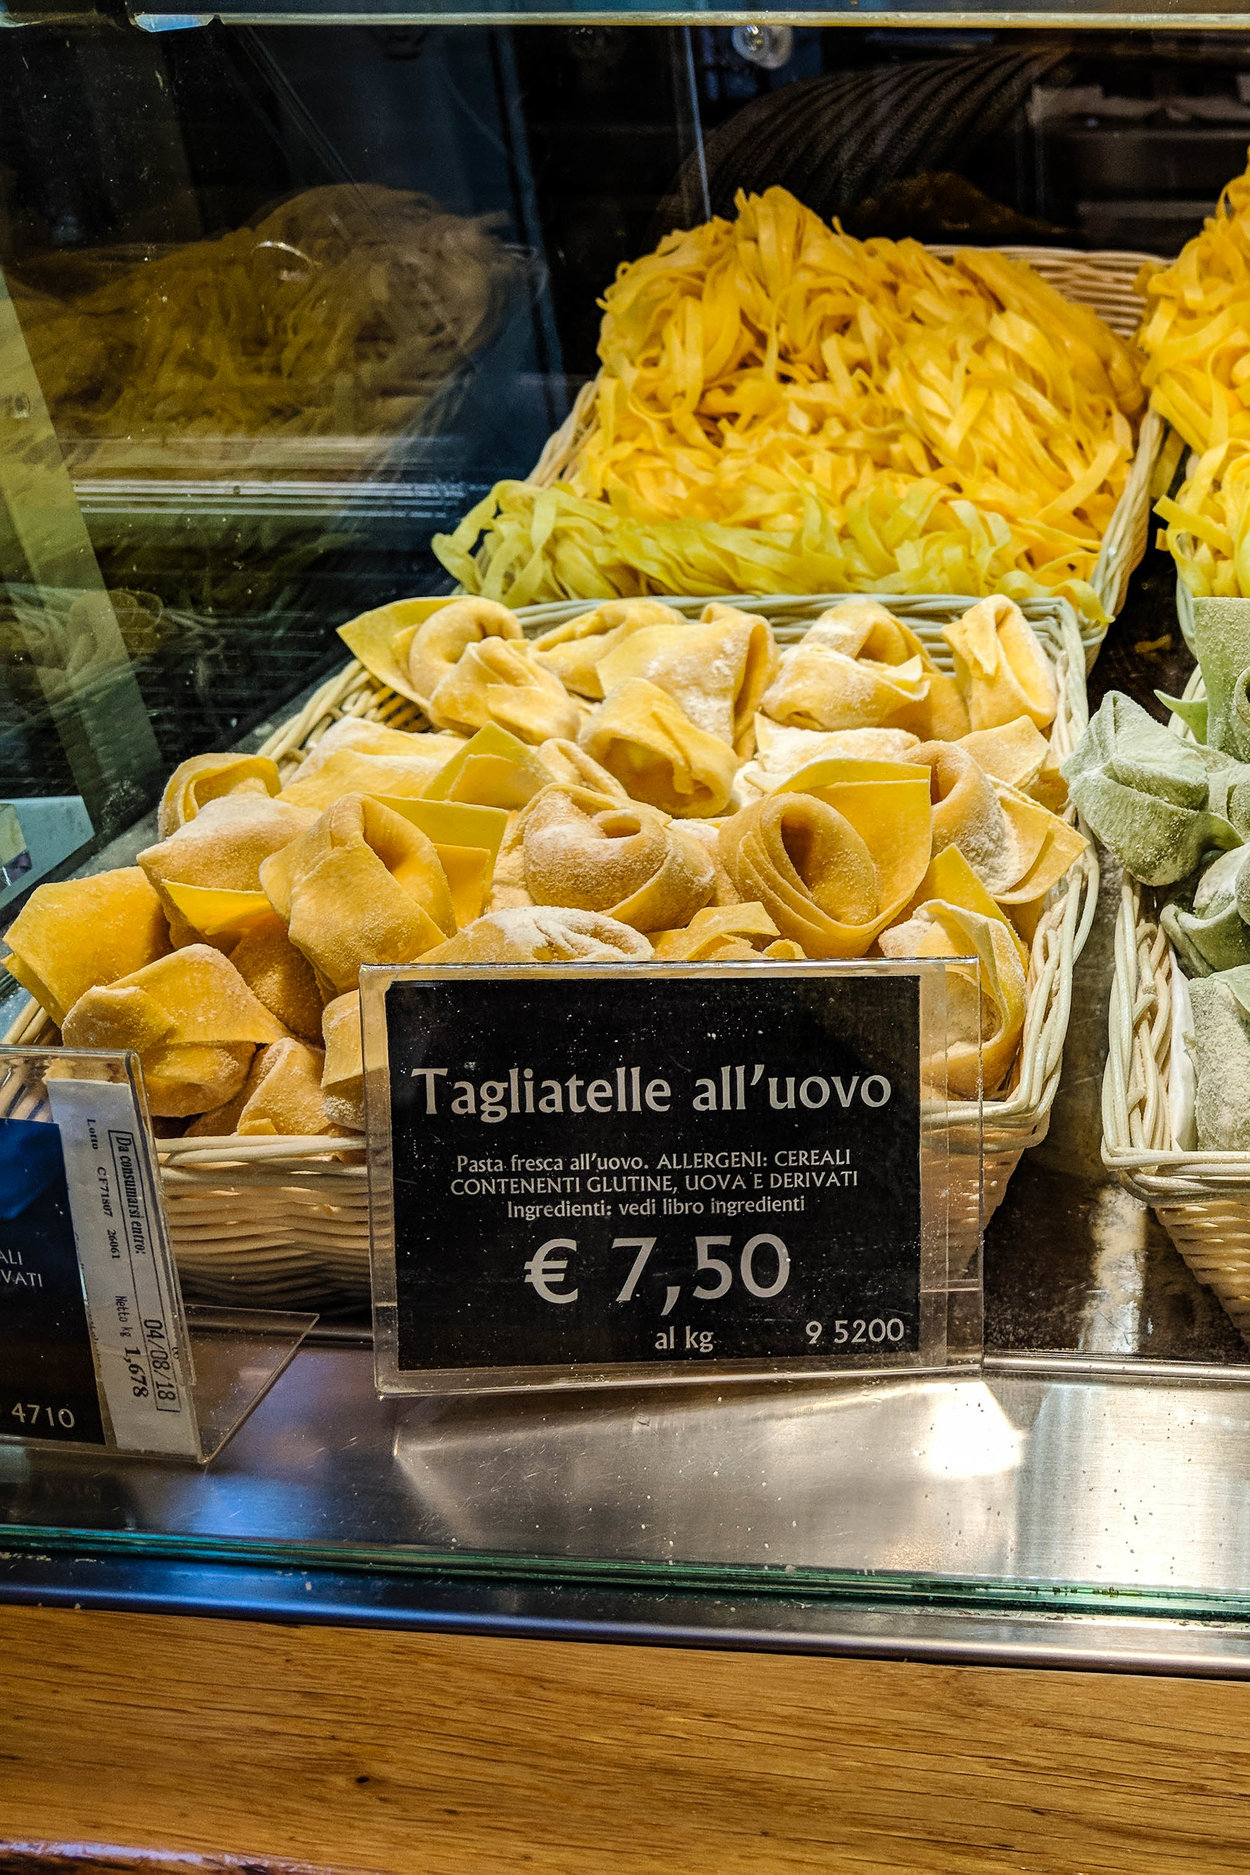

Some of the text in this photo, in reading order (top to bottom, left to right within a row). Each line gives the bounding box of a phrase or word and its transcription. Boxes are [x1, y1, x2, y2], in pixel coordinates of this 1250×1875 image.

[410, 1064, 891, 1123] Tagliatelle all'uovo
[87, 1118, 98, 1150] Lotto
[115, 1135, 132, 1153] Da
[457, 1149, 851, 1172] Pasta fresca all'uovo. ALLERGENI: CEREALI
[120, 1155, 144, 1219] consumarsi
[450, 1171, 858, 1195] CONTENENTI GLUTINE, UOVA E DERIVATI
[507, 1195, 805, 1221] Ingredienti: vedi libro ingredienti
[107, 1229, 120, 1259] 26061
[131, 1221, 146, 1255] entro:
[524, 1232, 791, 1317] € 7,50
[115, 1295, 130, 1323] Netto
[120, 1327, 133, 1338] kg
[654, 1325, 715, 1353] al kg
[805, 1317, 905, 1346] 9 5200
[124, 1347, 149, 1399] 1,678
[143, 1318, 176, 1401] 04/08/18
[11, 1402, 76, 1429] 4710
